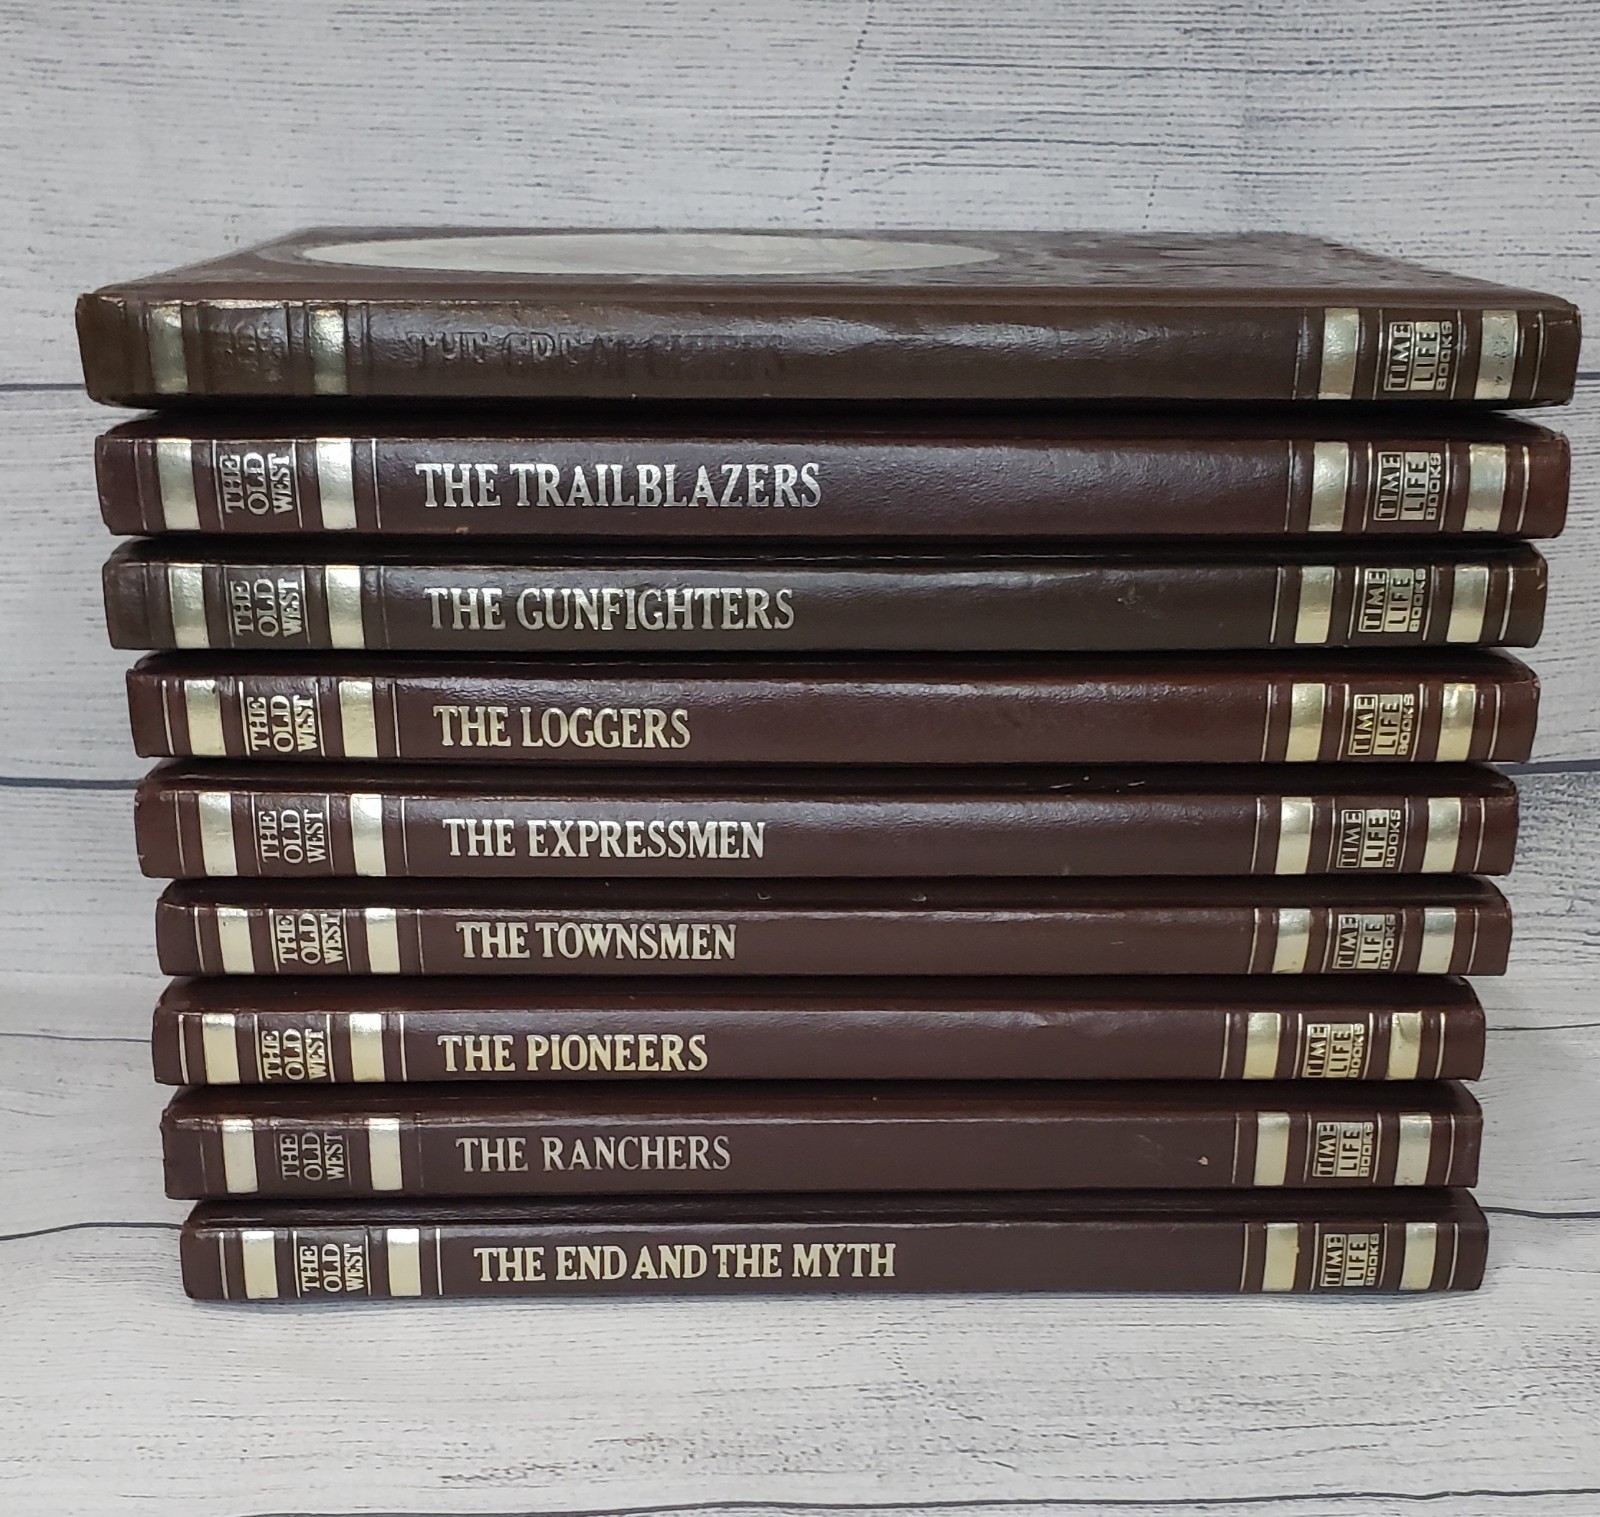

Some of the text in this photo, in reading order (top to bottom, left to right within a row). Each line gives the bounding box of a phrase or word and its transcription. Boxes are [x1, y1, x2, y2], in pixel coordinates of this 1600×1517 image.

[1387, 322, 1411, 387] TIME
[1413, 328, 1439, 385] LIFE
[1435, 320, 1452, 391] BOOKS
[220, 455, 245, 514] THE
[243, 452, 269, 515] OLD
[267, 453, 294, 515] WEST
[415, 462, 822, 508] THE TRAILBLAZERS
[1377, 453, 1400, 519] TIME
[1404, 459, 1429, 515] LIFE
[1425, 452, 1441, 520] BOOKS
[230, 581, 254, 637] THE
[254, 579, 279, 637] OLD
[277, 578, 303, 637] WEST
[424, 587, 795, 632] THE GUNFIGHTERS
[1362, 570, 1386, 630] TIME
[1388, 576, 1412, 626] LIFE
[1409, 568, 1426, 632] BOOKS
[247, 697, 270, 751] THE
[270, 695, 294, 753] OLD
[293, 694, 318, 752] WEST
[433, 706, 691, 750] THE LOGGERS
[1351, 696, 1374, 754] TIME
[1376, 700, 1400, 748] LIFE
[1397, 693, 1415, 756] BOOKS
[259, 810, 280, 864] THE
[281, 809, 304, 864] OLD
[304, 809, 327, 864] WEST
[442, 819, 766, 859] THE EXPRESSMEN
[1340, 812, 1363, 866] TIME
[1364, 815, 1387, 861] LIFE
[1385, 809, 1401, 868] BOOKS
[276, 914, 298, 963] THE
[299, 913, 321, 965] OLD
[320, 913, 344, 964] WEST
[456, 922, 737, 961] THE TOWNSMEN
[1336, 916, 1359, 968] TIME
[1360, 922, 1383, 969] LIFE
[1379, 913, 1396, 970] BOOKS
[262, 1030, 283, 1080] THE
[283, 1028, 306, 1080] OLD
[305, 1028, 328, 1080] WEST
[437, 1035, 709, 1073] THE PIONEERS
[1305, 1024, 1328, 1077] TIME
[1328, 1029, 1351, 1073] LIFE
[1347, 1022, 1365, 1078] BOOKS
[279, 1133, 300, 1181] THE
[302, 1131, 324, 1182] OLD
[324, 1133, 345, 1181] WEST
[455, 1136, 731, 1174] THE RANCHERS
[1315, 1123, 1338, 1176] TIME
[1339, 1129, 1361, 1173] LIFE
[1359, 1121, 1374, 1177] BOOKS
[300, 1246, 320, 1292] THE
[322, 1243, 343, 1293] OLD
[343, 1244, 364, 1292] WEST
[473, 1244, 896, 1283] THE END AND THE MYTH
[1322, 1236, 1343, 1286] TIME
[1346, 1240, 1368, 1282] LIFE
[1365, 1233, 1380, 1288] BOOKS
